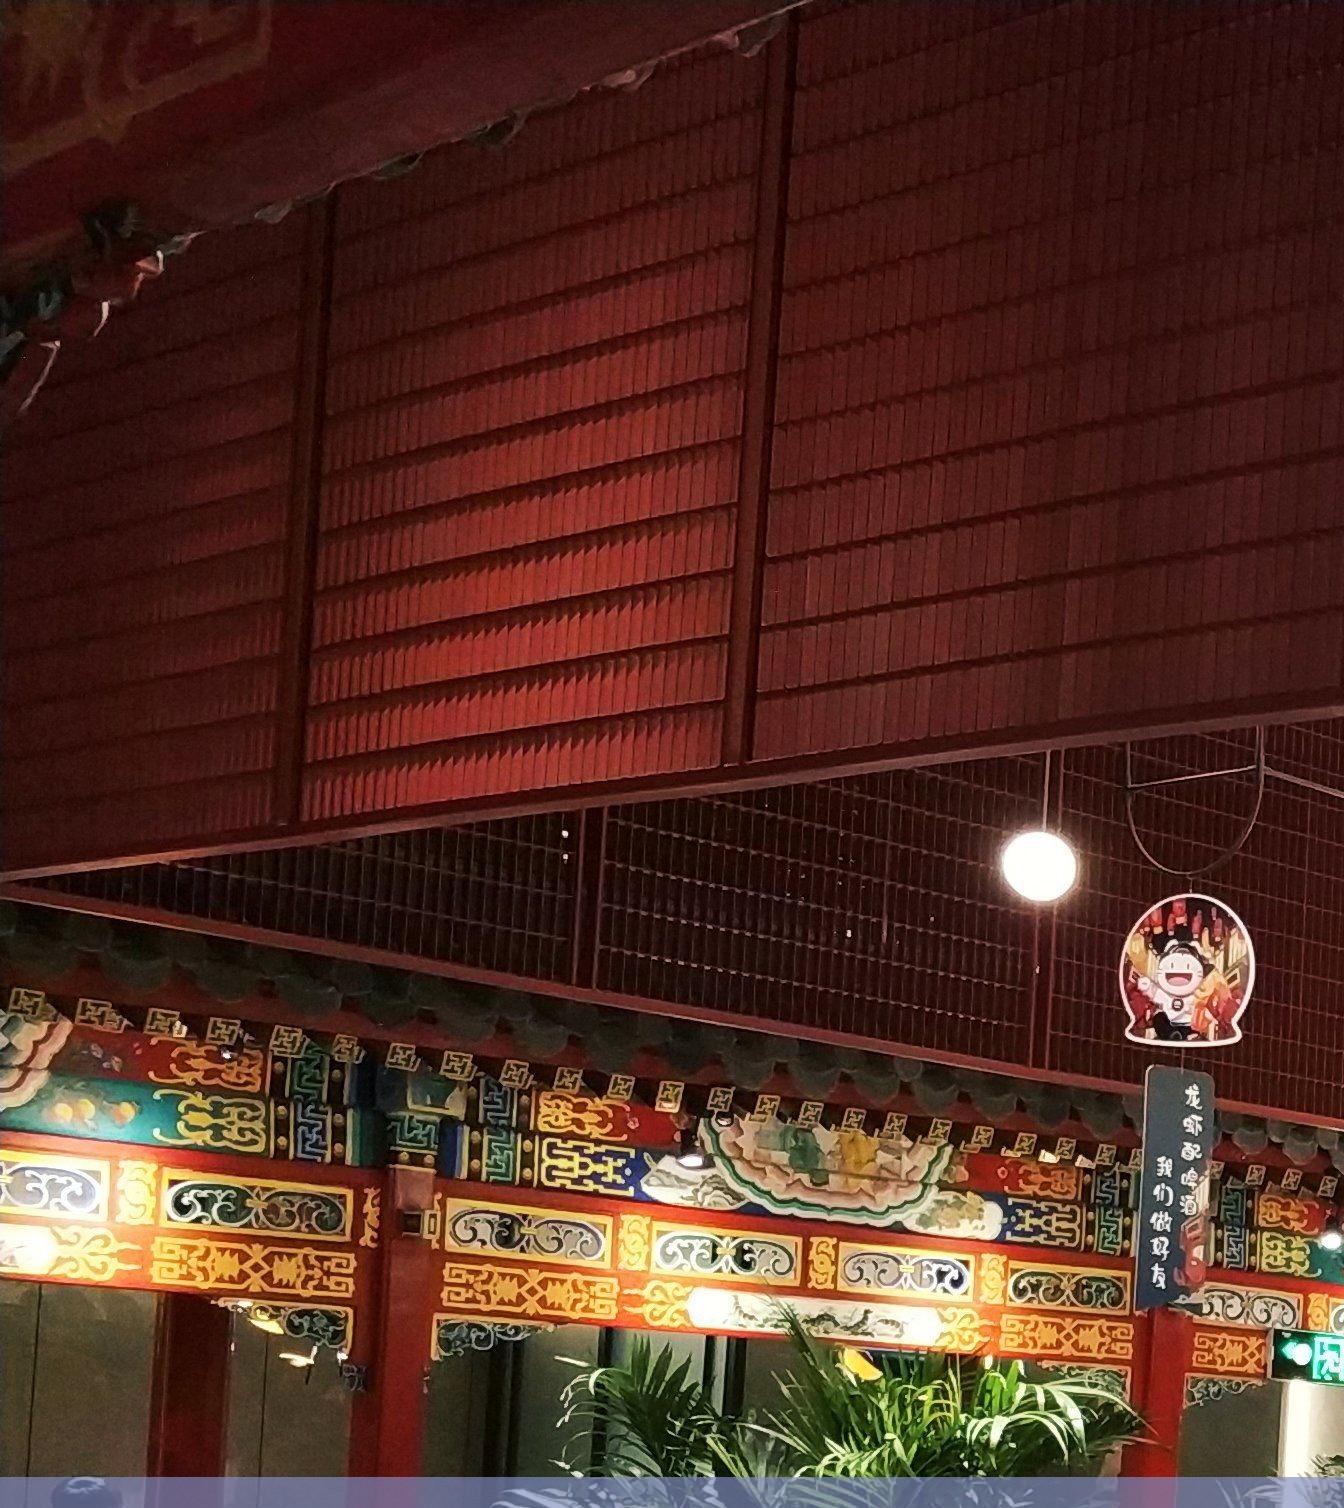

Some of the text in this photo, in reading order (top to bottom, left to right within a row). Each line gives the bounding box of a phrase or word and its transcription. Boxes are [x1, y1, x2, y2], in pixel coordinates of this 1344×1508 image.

[1149, 1156, 1174, 1290] 我们做好友
